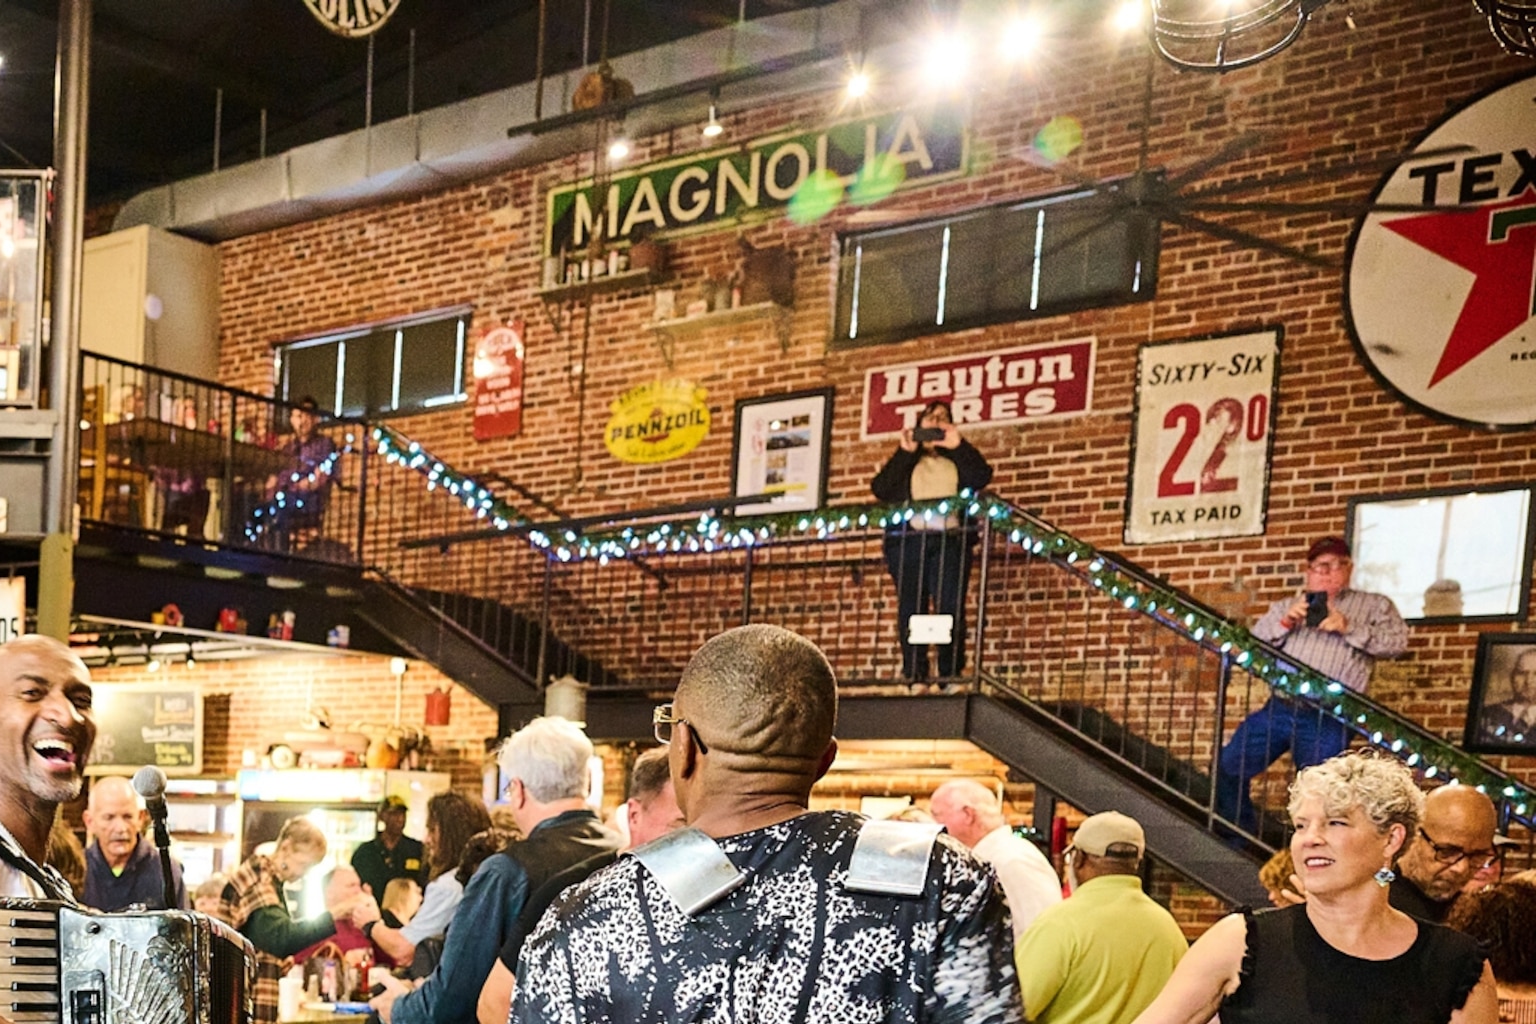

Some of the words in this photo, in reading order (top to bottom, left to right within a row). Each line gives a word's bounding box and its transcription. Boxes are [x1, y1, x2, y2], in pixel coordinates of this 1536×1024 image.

[572, 112, 934, 247] MAGNOLIA
[881, 354, 1075, 404] Dayton
[1149, 353, 1267, 385] SIXTY-SIX
[610, 408, 705, 443] PENNZOIL
[895, 388, 1057, 429] TRES
[1150, 509, 1186, 525] TAX
[1194, 505, 1242, 522] PAID
